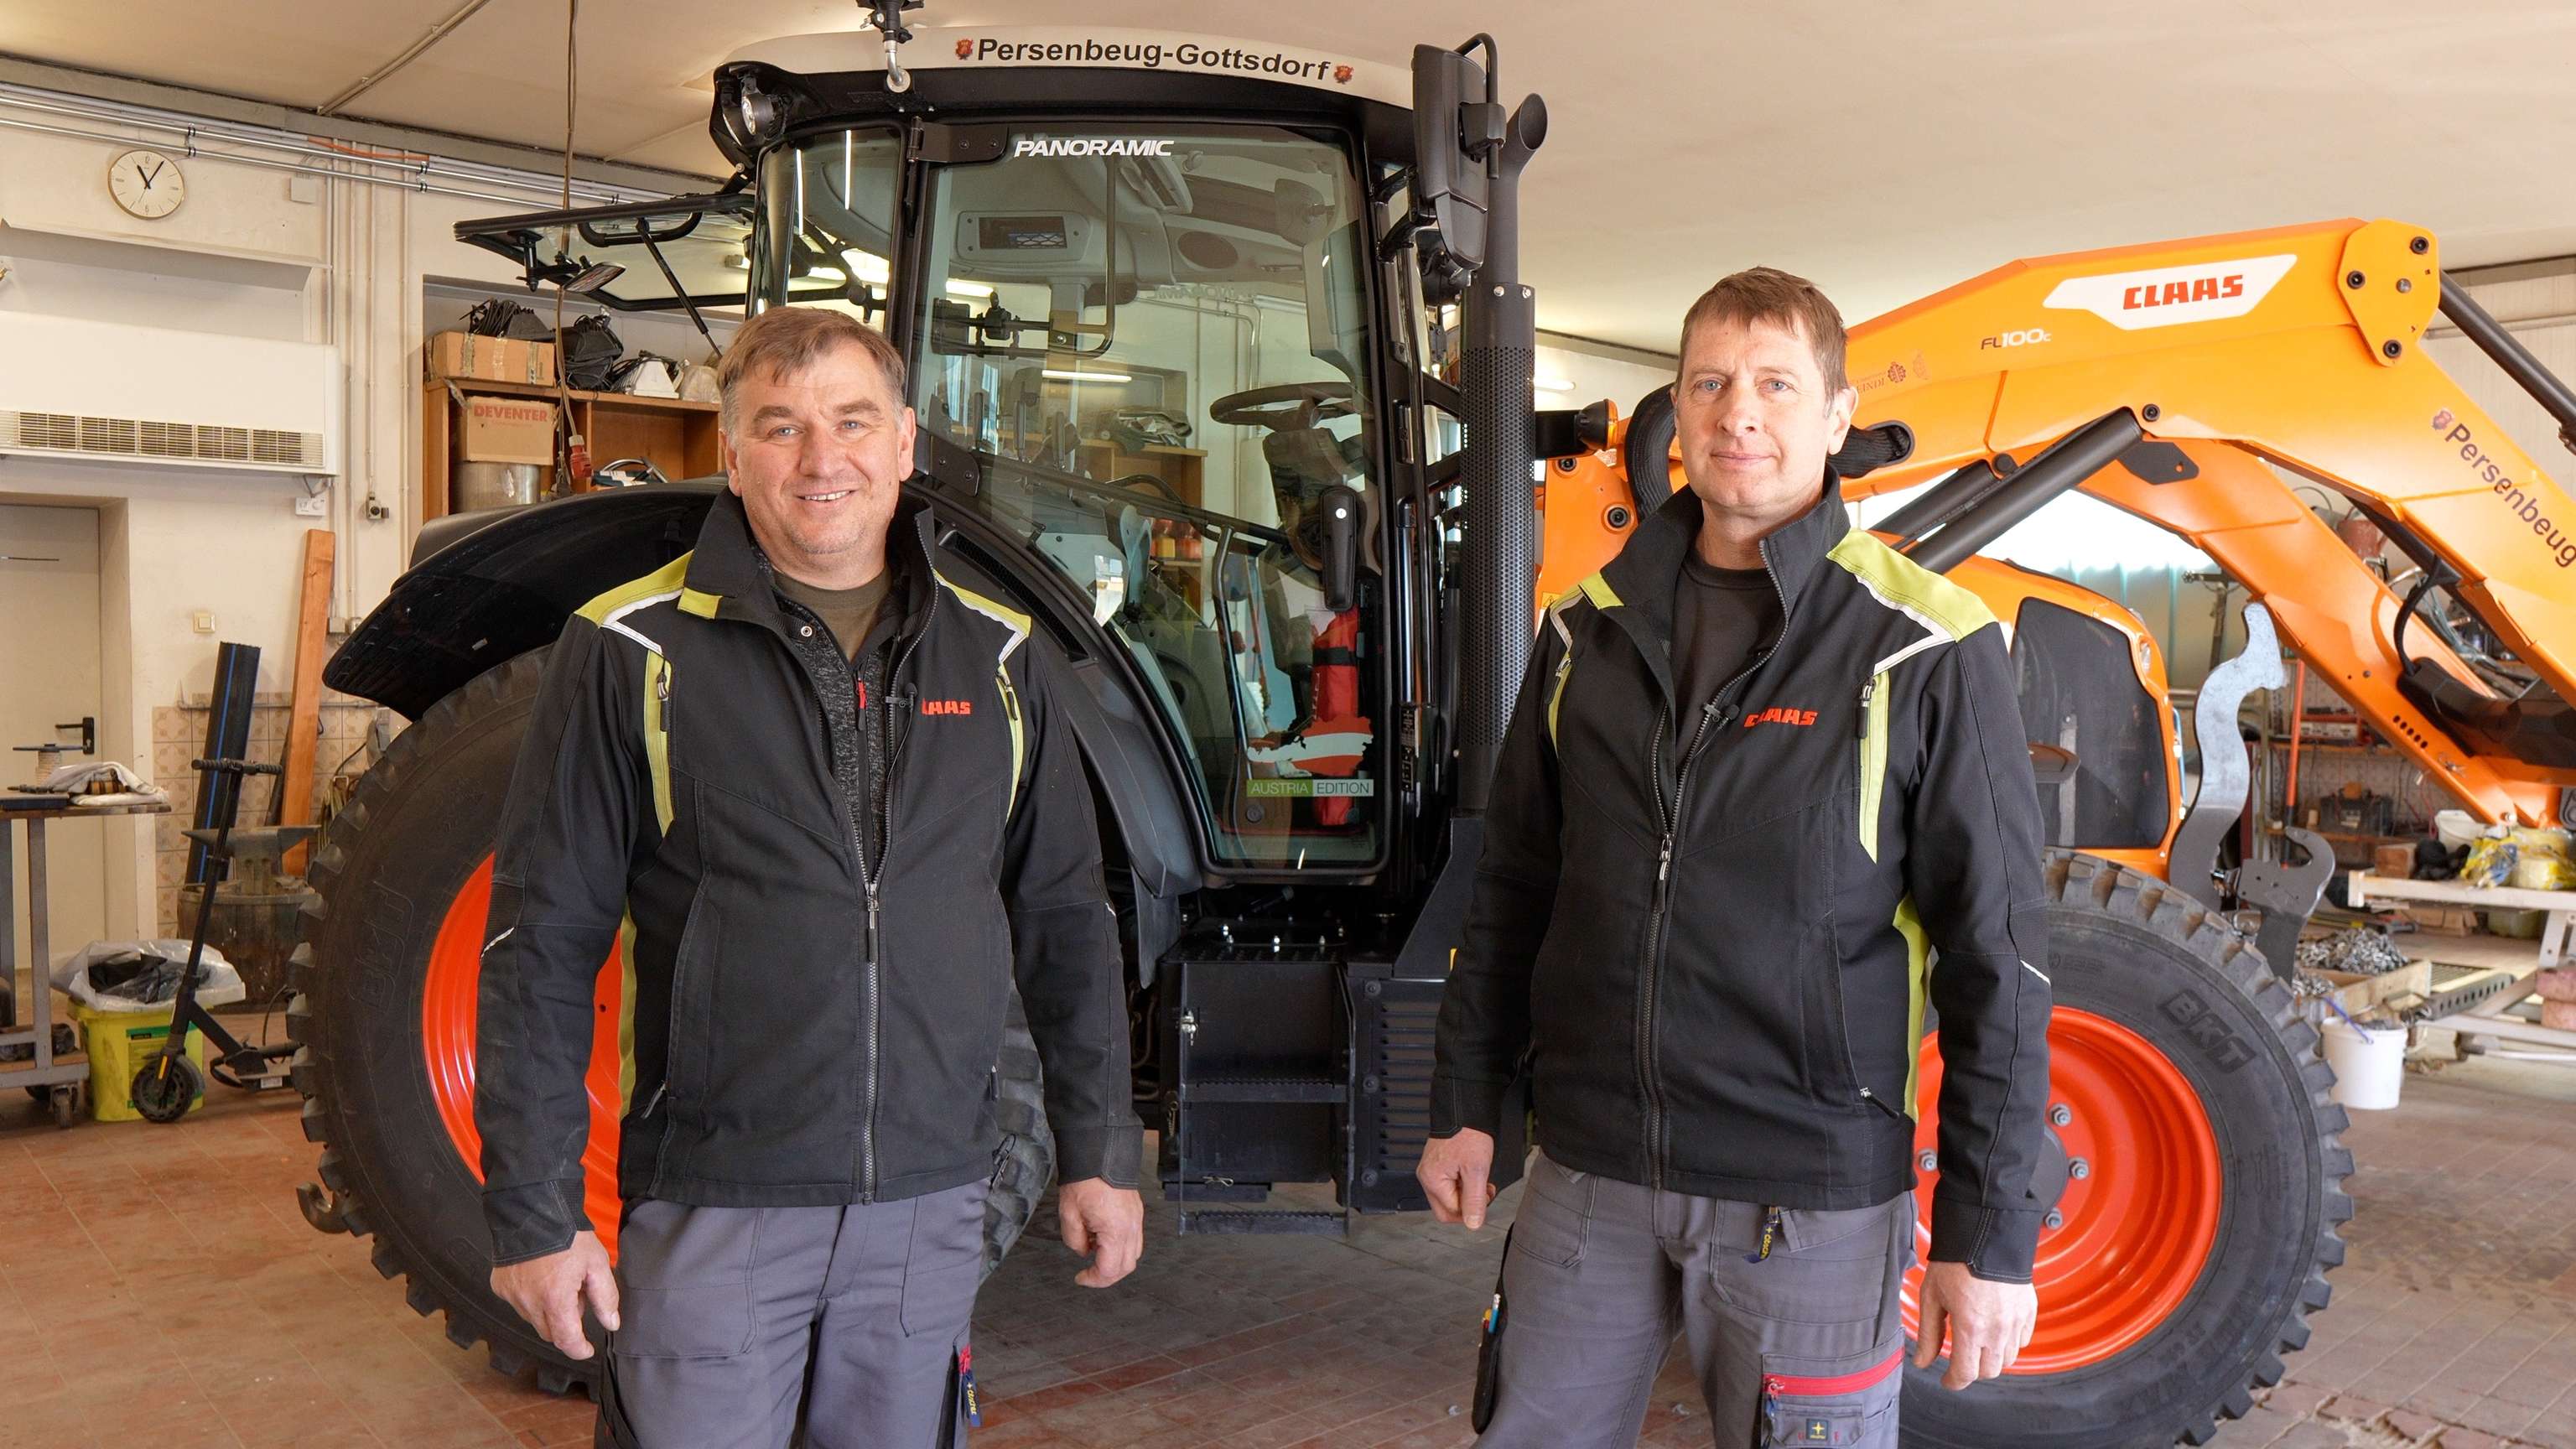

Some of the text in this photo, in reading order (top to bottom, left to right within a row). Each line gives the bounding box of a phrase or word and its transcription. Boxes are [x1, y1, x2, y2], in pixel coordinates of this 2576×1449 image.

[977, 38, 1332, 81] Persenbeug-Gottsdorf
[1013, 139, 1175, 158] PANORAMIC
[2122, 274, 2243, 310] CLAAS
[473, 405, 548, 422] DEVENTER
[2444, 423, 2576, 569] Persenbeug
[922, 698, 972, 715] LAAS
[1250, 782, 1369, 794] AUSTRIA EDITION
[2158, 991, 2256, 1073] BKT
